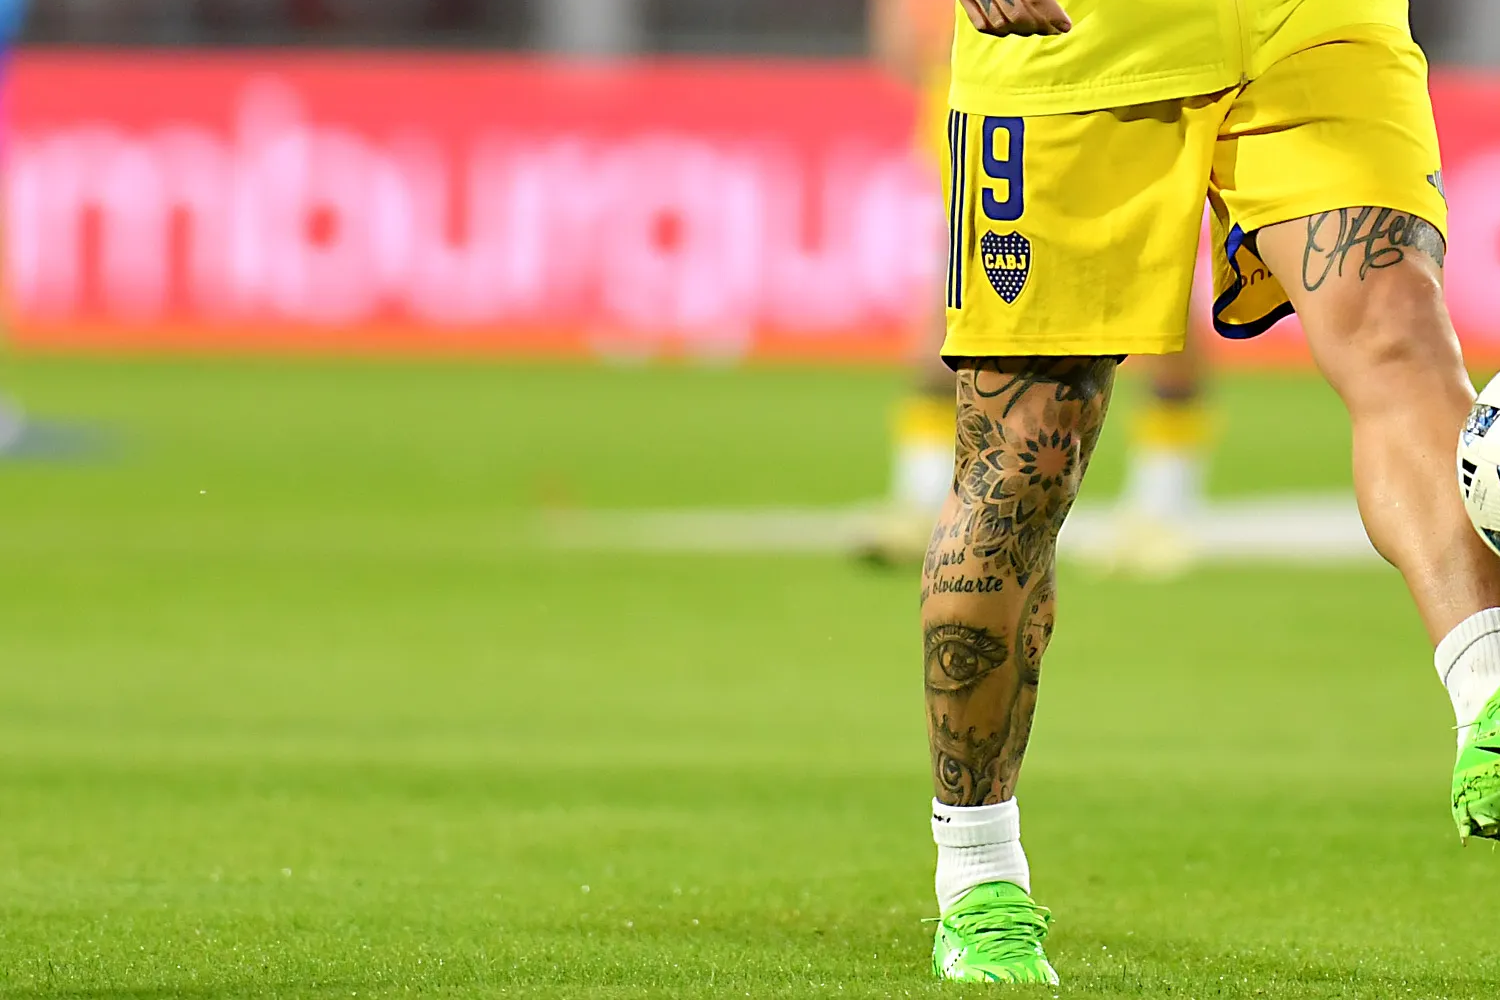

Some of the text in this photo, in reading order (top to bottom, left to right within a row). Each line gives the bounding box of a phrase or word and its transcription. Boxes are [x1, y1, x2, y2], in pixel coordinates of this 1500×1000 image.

[982, 116, 1025, 221] 9
[984, 254, 1027, 270] CABJ
[932, 574, 1004, 595] olvidarte
